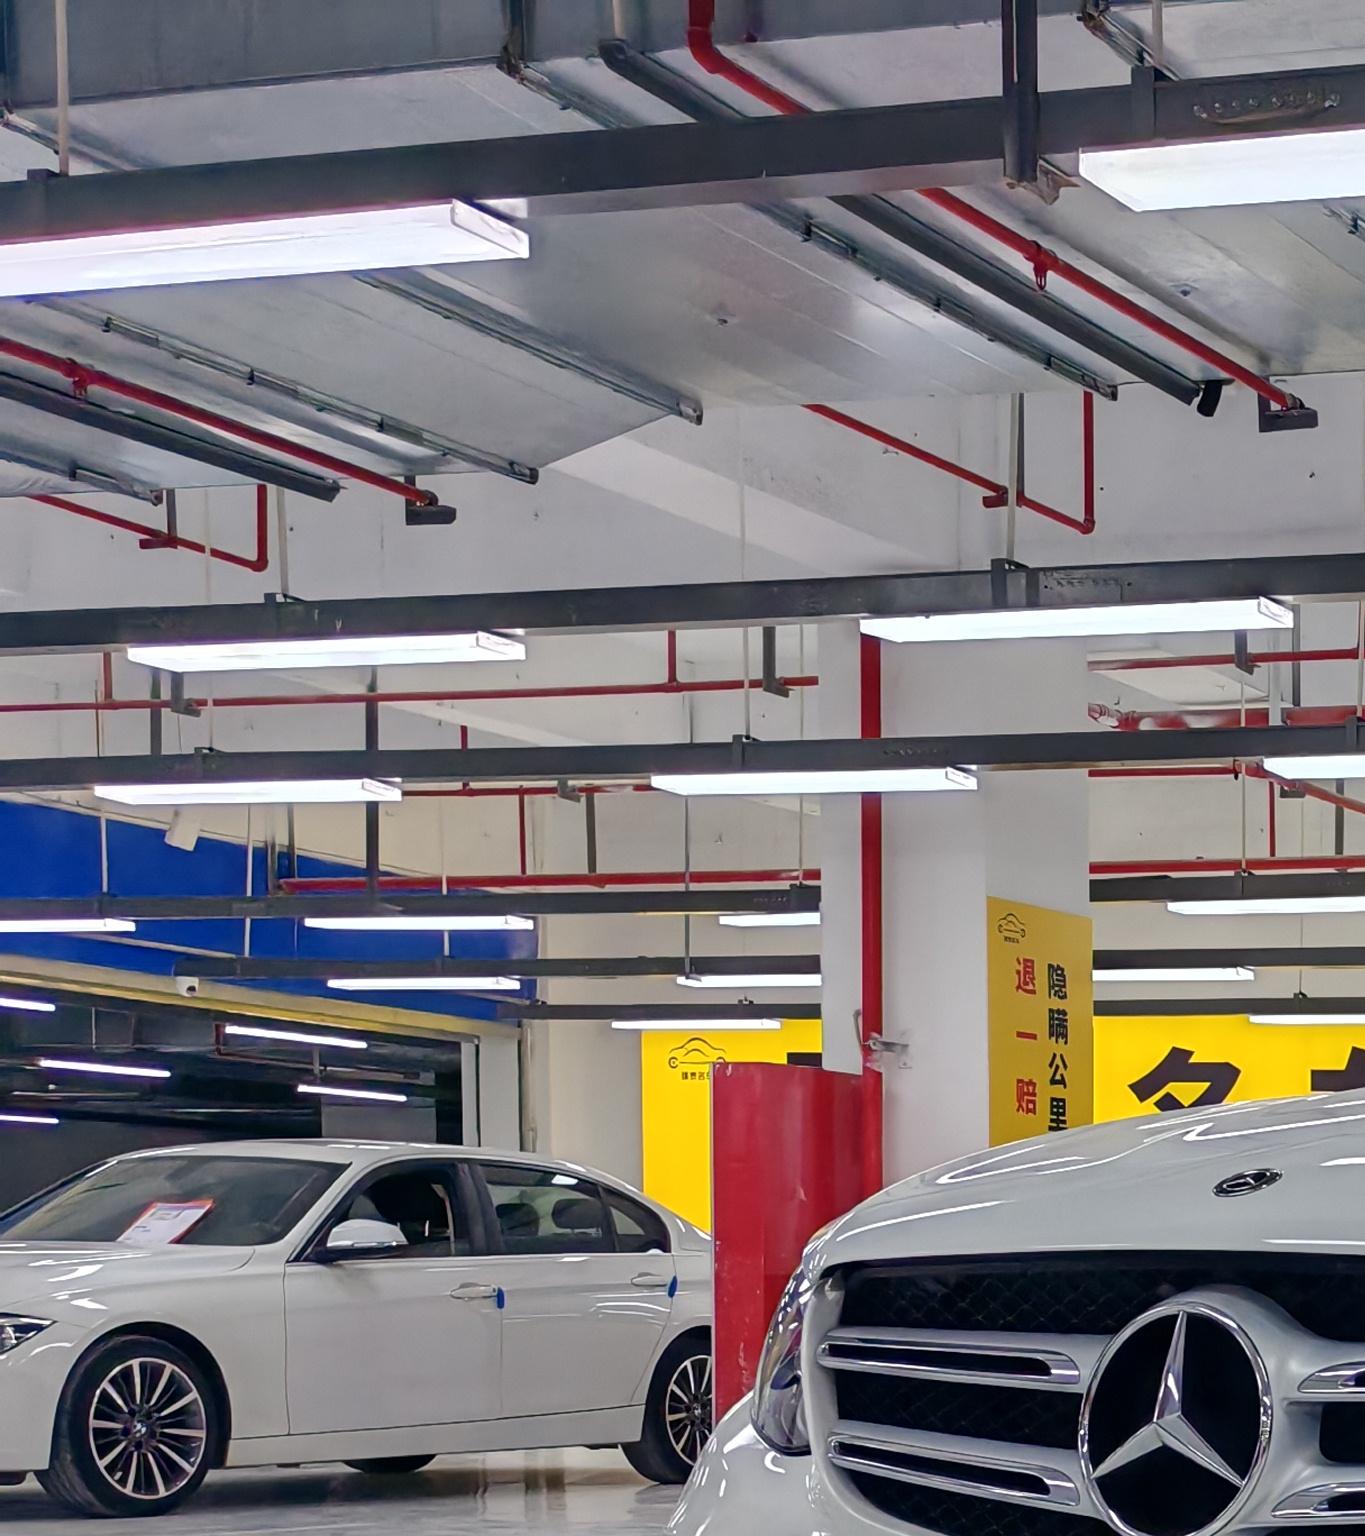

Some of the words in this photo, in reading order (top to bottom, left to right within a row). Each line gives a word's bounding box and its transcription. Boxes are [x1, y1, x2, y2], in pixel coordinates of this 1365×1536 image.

[1015, 957, 1038, 1116] 退一赔
[1046, 963, 1069, 1131] 隐瞒公里
